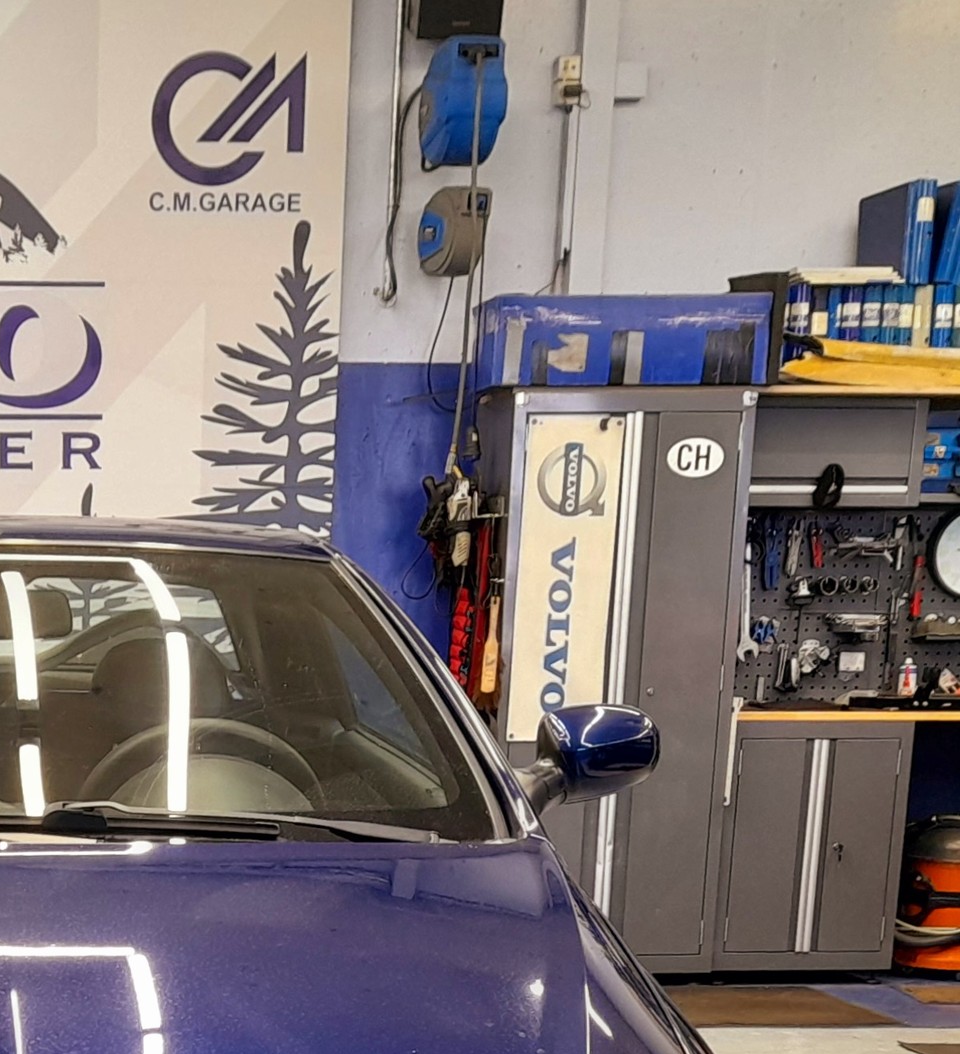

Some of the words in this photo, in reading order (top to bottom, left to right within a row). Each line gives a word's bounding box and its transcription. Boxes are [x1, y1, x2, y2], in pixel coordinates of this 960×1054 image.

[149, 191, 301, 213] C.M.GARAGE
[564, 446, 580, 513] VOLVO
[677, 443, 711, 471] CH
[540, 536, 577, 713] VOLVO
